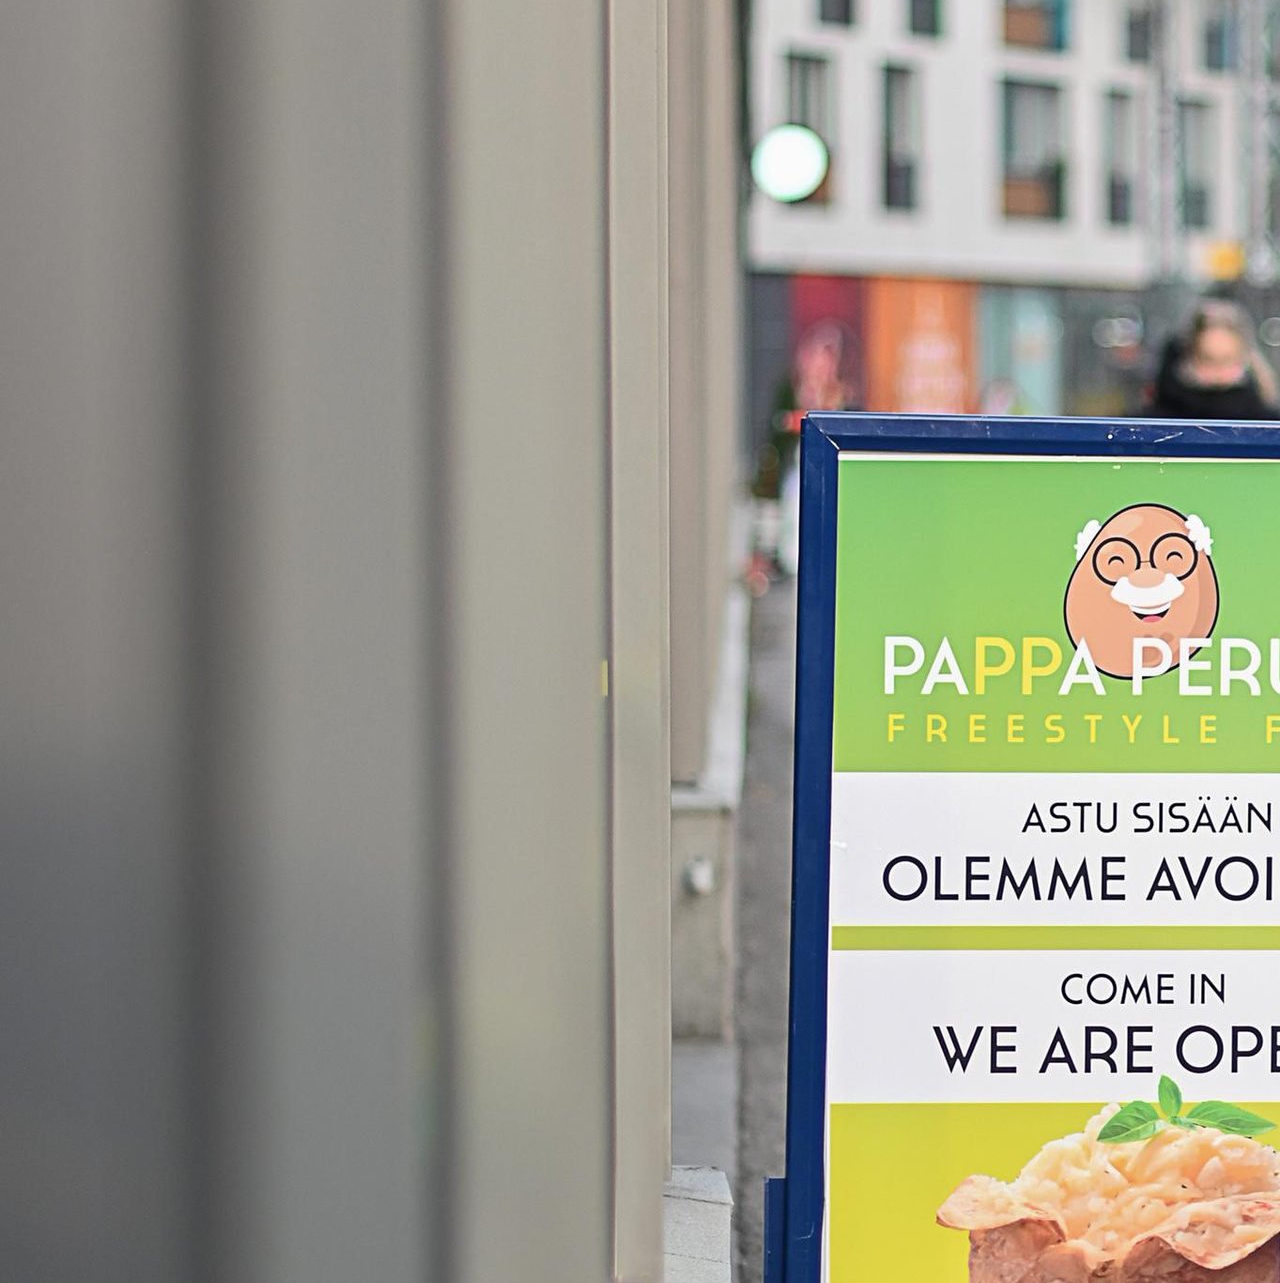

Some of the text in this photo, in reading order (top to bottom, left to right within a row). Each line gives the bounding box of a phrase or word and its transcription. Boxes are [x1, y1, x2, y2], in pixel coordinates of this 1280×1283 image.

[883, 635, 1105, 696] PAPPA
[887, 713, 1218, 744] FREESTYLE
[1021, 795, 1272, 834] ASTU SISÄÄN
[882, 855, 1127, 902] OLEMME
[1060, 973, 1226, 1005] COME IN
[933, 1025, 1018, 1074] WE
[1039, 1025, 1154, 1074] ARE
